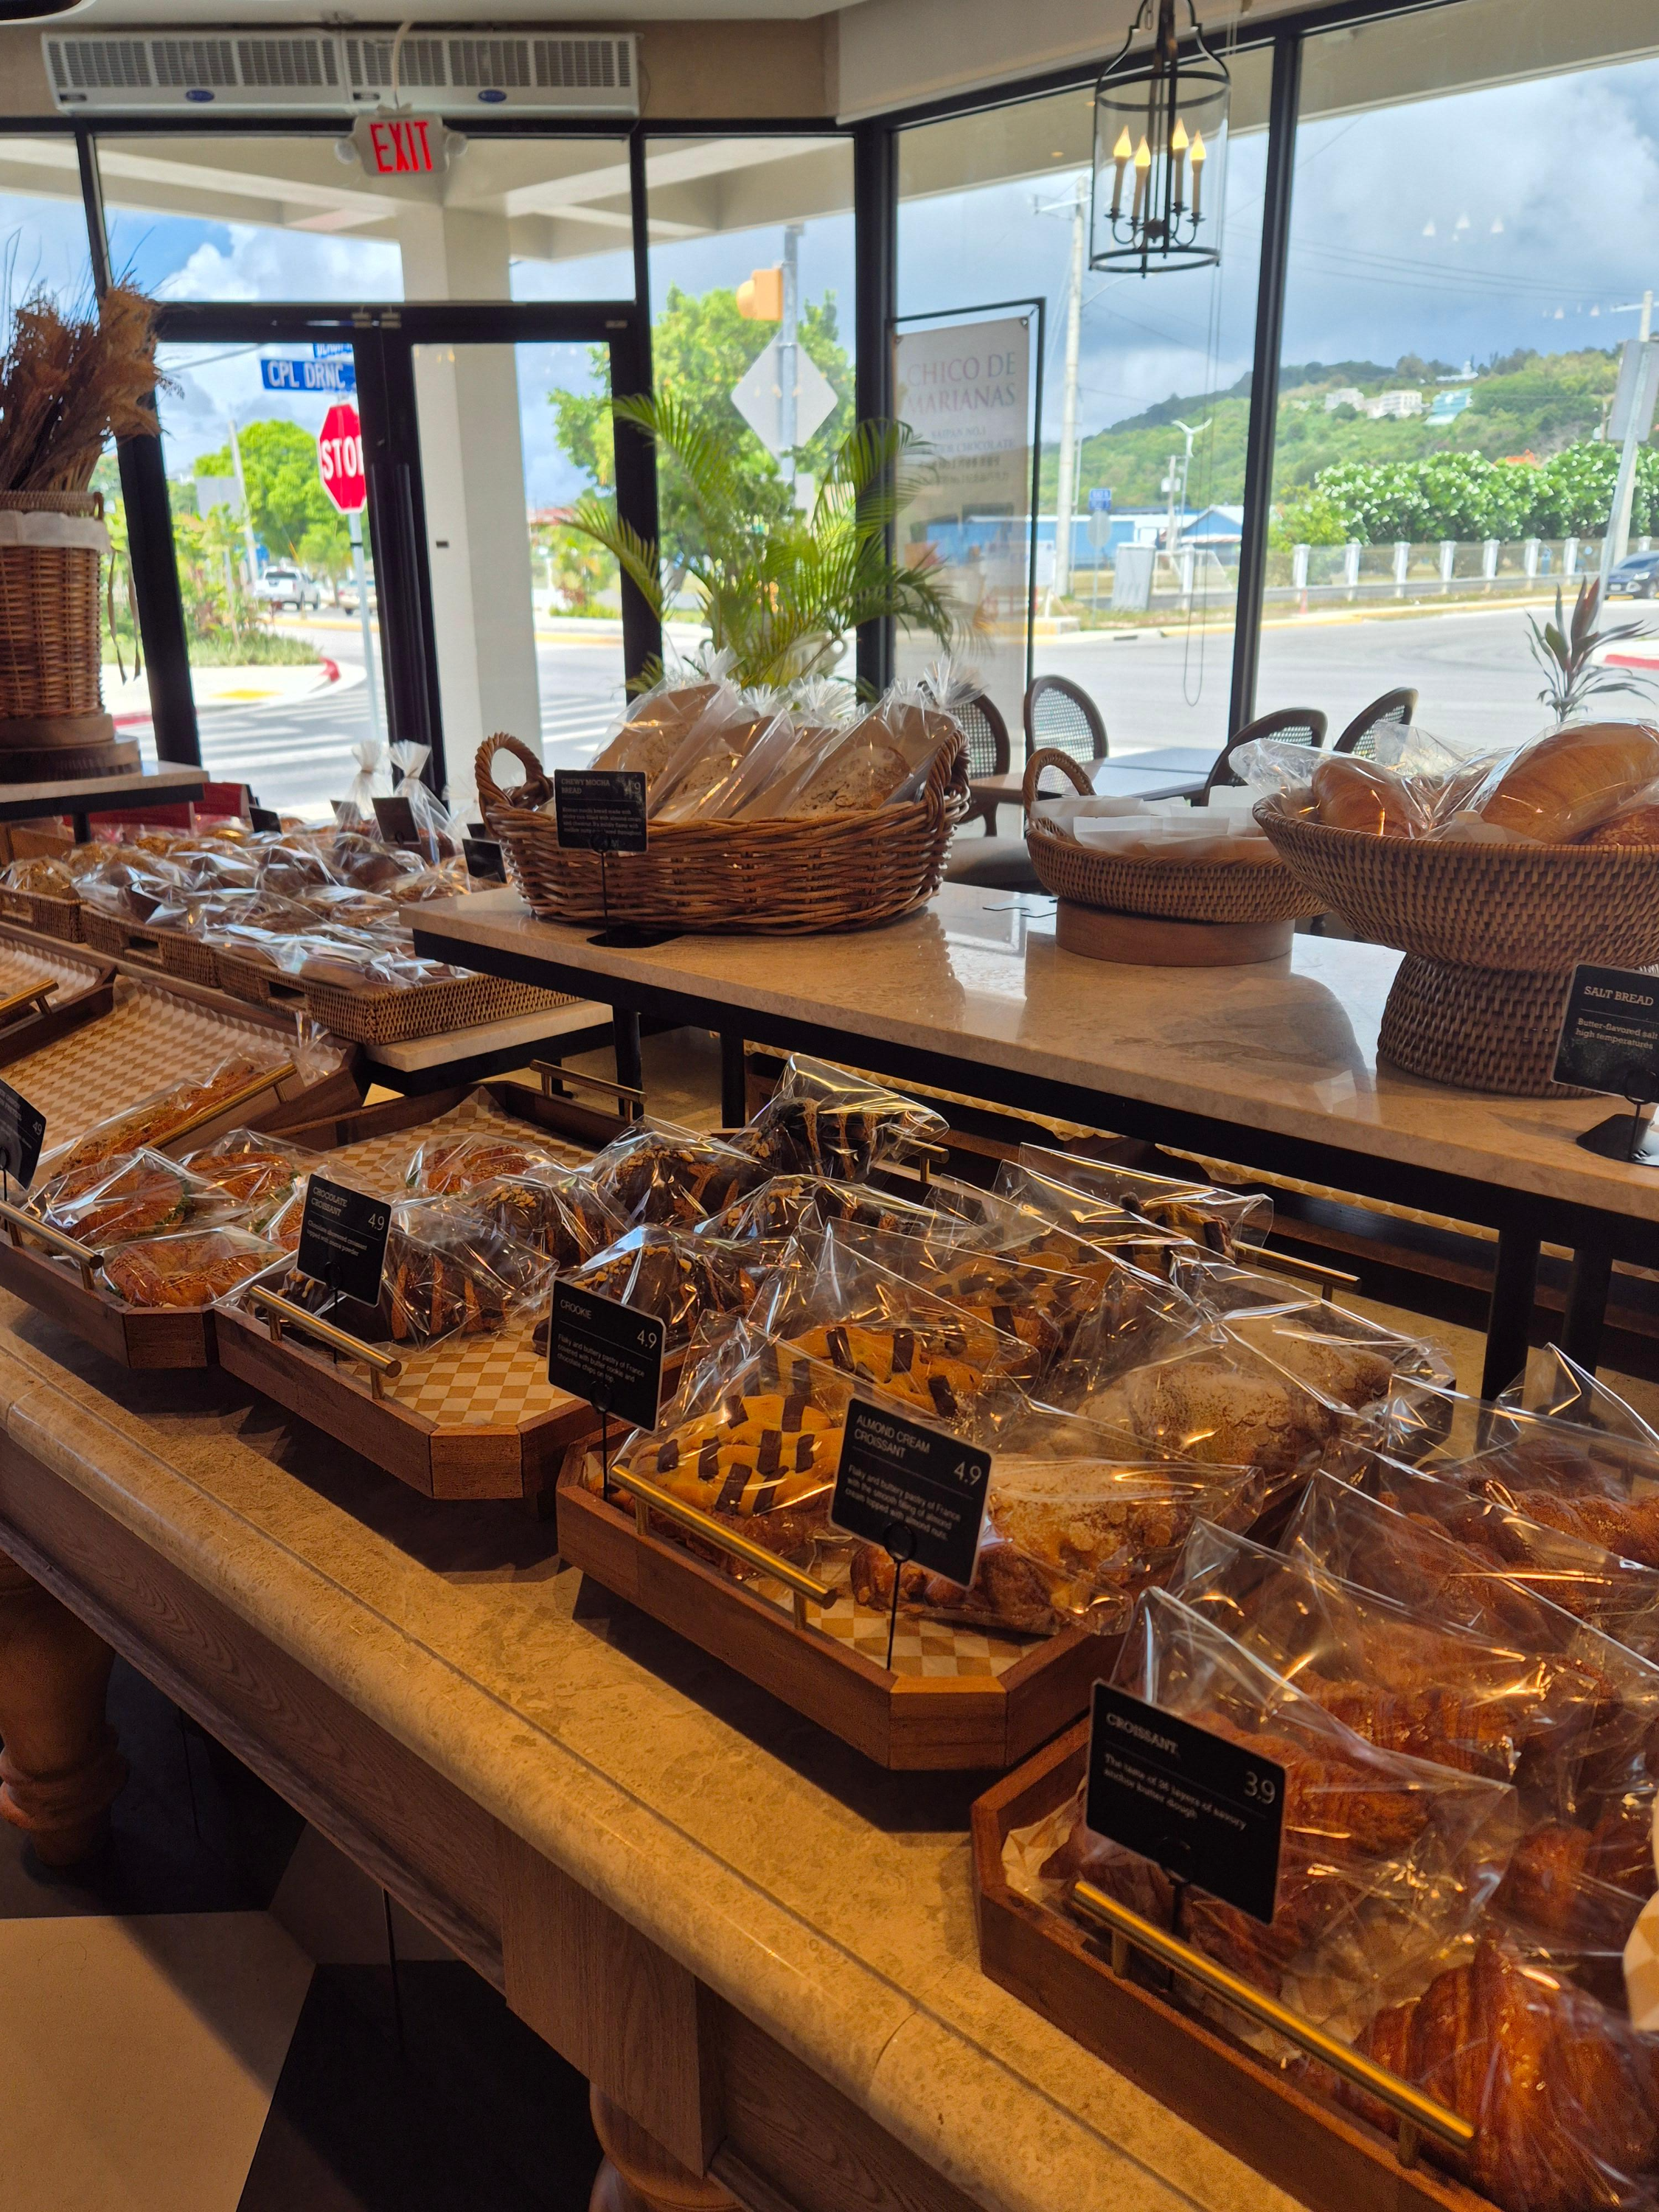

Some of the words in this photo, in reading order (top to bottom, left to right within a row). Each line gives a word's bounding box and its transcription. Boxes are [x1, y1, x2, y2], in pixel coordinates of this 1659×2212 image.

[370, 122, 432, 173] EXIT
[267, 361, 299, 388] CPL
[305, 362, 346, 389] DRNC
[907, 357, 980, 386] CHICO
[988, 352, 1016, 378] DE
[908, 382, 1015, 414] MARIANAS
[1584, 986, 1613, 999] SALT
[1614, 991, 1654, 1006] BREAD
[1575, 1028, 1595, 1039] high
[1596, 1033, 1653, 1050] temperatures
[1577, 1018, 1641, 1037] Butter-flavored
[311, 1197, 342, 1217] CROISSANT
[313, 1186, 348, 1207] CHOCOLATE
[368, 1213, 385, 1231] 4.9
[560, 1299, 592, 1320] CROOKIE
[637, 1329, 657, 1349] 4.9
[557, 1344, 578, 1357] covered
[579, 1354, 589, 1362] with
[590, 1357, 605, 1368] butter
[606, 1366, 624, 1377] cookie
[625, 1374, 635, 1382] and
[557, 1353, 581, 1368] chocolate
[582, 1364, 596, 1374] chips
[558, 1333, 572, 1346] Flaky
[572, 1341, 582, 1350] and
[583, 1345, 601, 1360] buttery
[602, 1354, 619, 1367] pastry
[626, 1363, 644, 1377] France
[854, 1428, 906, 1458] CROISSANT
[856, 1414, 895, 1439] ALMOND
[896, 1430, 931, 1453] CREAM
[953, 1461, 982, 1486] 4.9
[848, 1464, 866, 1481] Flaky
[866, 1475, 880, 1486] and
[880, 1479, 904, 1498] buttery
[904, 1492, 926, 1507] pastry
[927, 1501, 936, 1509] of
[936, 1503, 961, 1522] France
[845, 1488, 866, 1503] cream
[866, 1497, 889, 1514] topped
[889, 1509, 904, 1520] with
[905, 1515, 931, 1532] almond
[917, 1509, 925, 1517] of
[925, 1513, 952, 1530] almond
[1106, 1713, 1178, 1754] CROISSANT
[1105, 1753, 1122, 1769] The
[1147, 1776, 1158, 1786] of
[1201, 1803, 1213, 1812] of
[1245, 1771, 1276, 1804] 3.9
